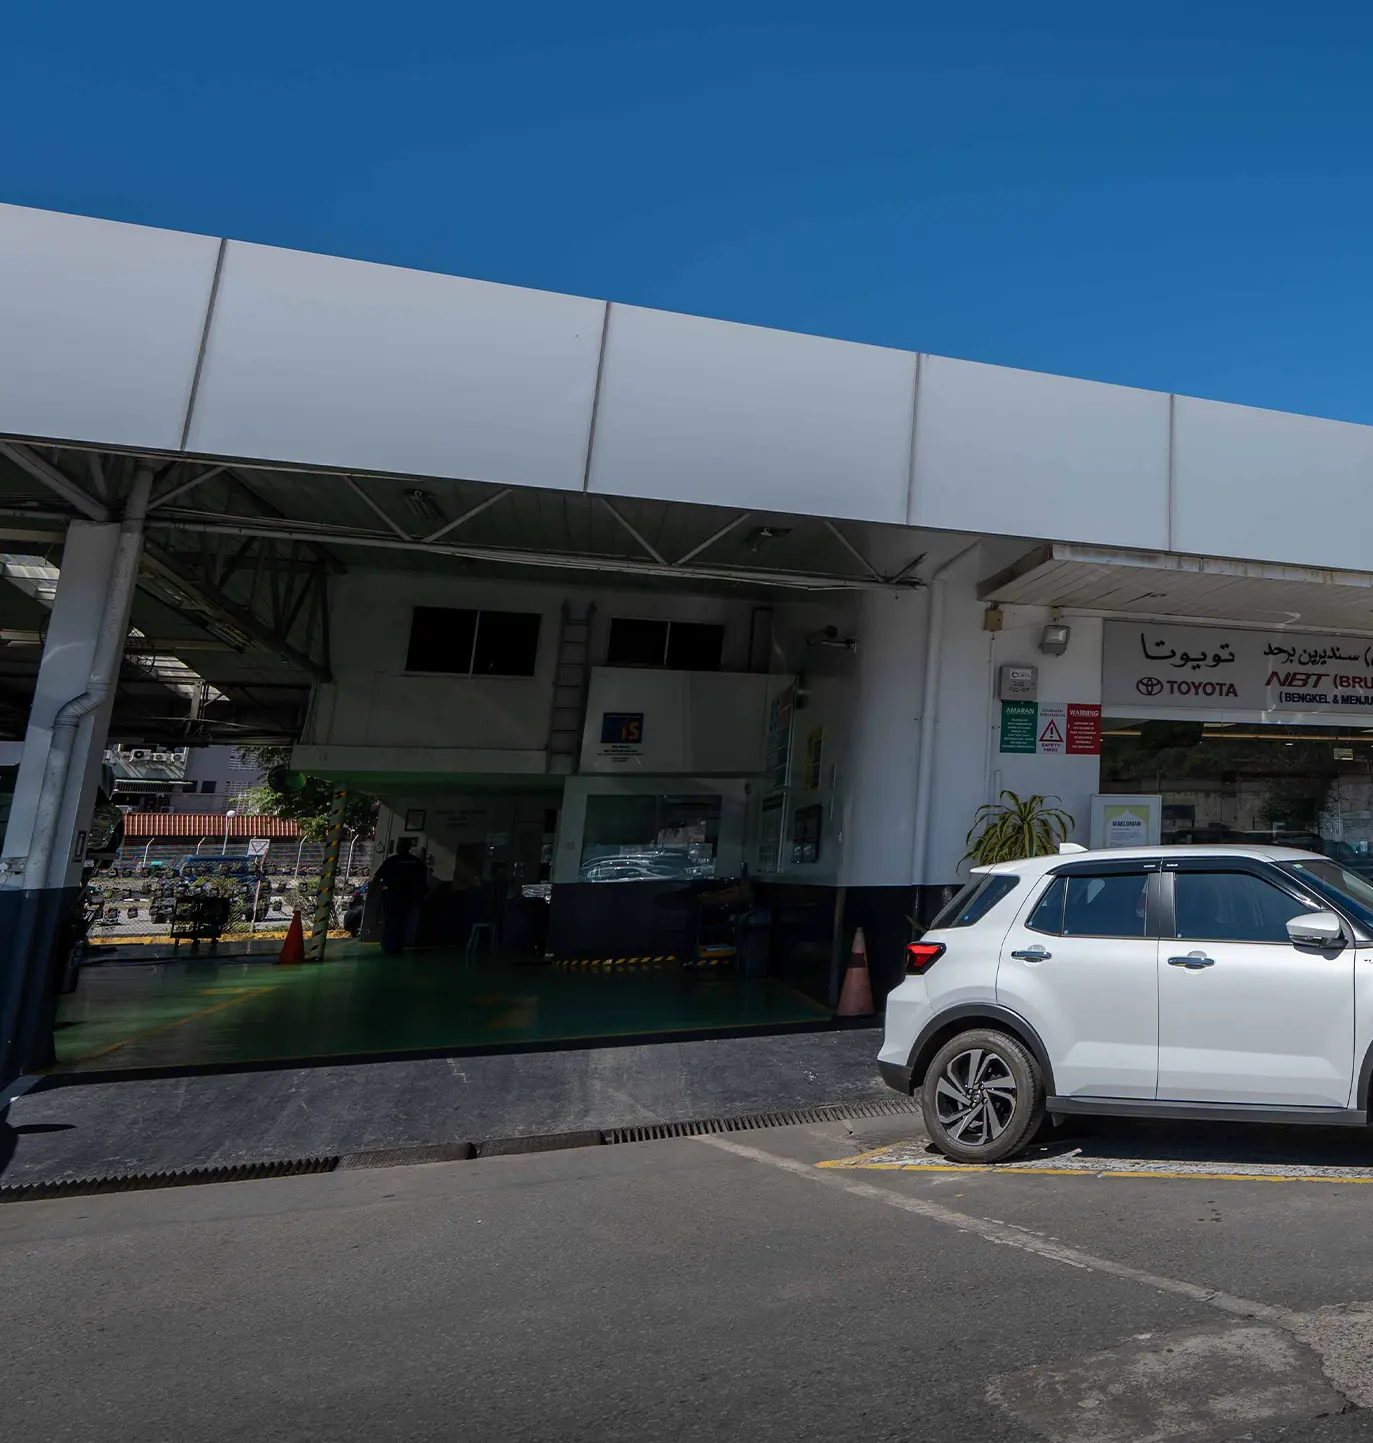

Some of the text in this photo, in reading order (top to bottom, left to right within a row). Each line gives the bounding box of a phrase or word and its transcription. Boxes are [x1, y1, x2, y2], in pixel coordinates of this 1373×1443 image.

[1140, 632, 1235, 670] تويوتا
[1263, 642, 1296, 664] برحد
[1265, 671, 1330, 688] NBT
[1166, 680, 1239, 698] TOYOTA
[1332, 694, 1340, 704] &
[1005, 706, 1035, 714] AMARAN
[1069, 709, 1100, 717] WARNING
